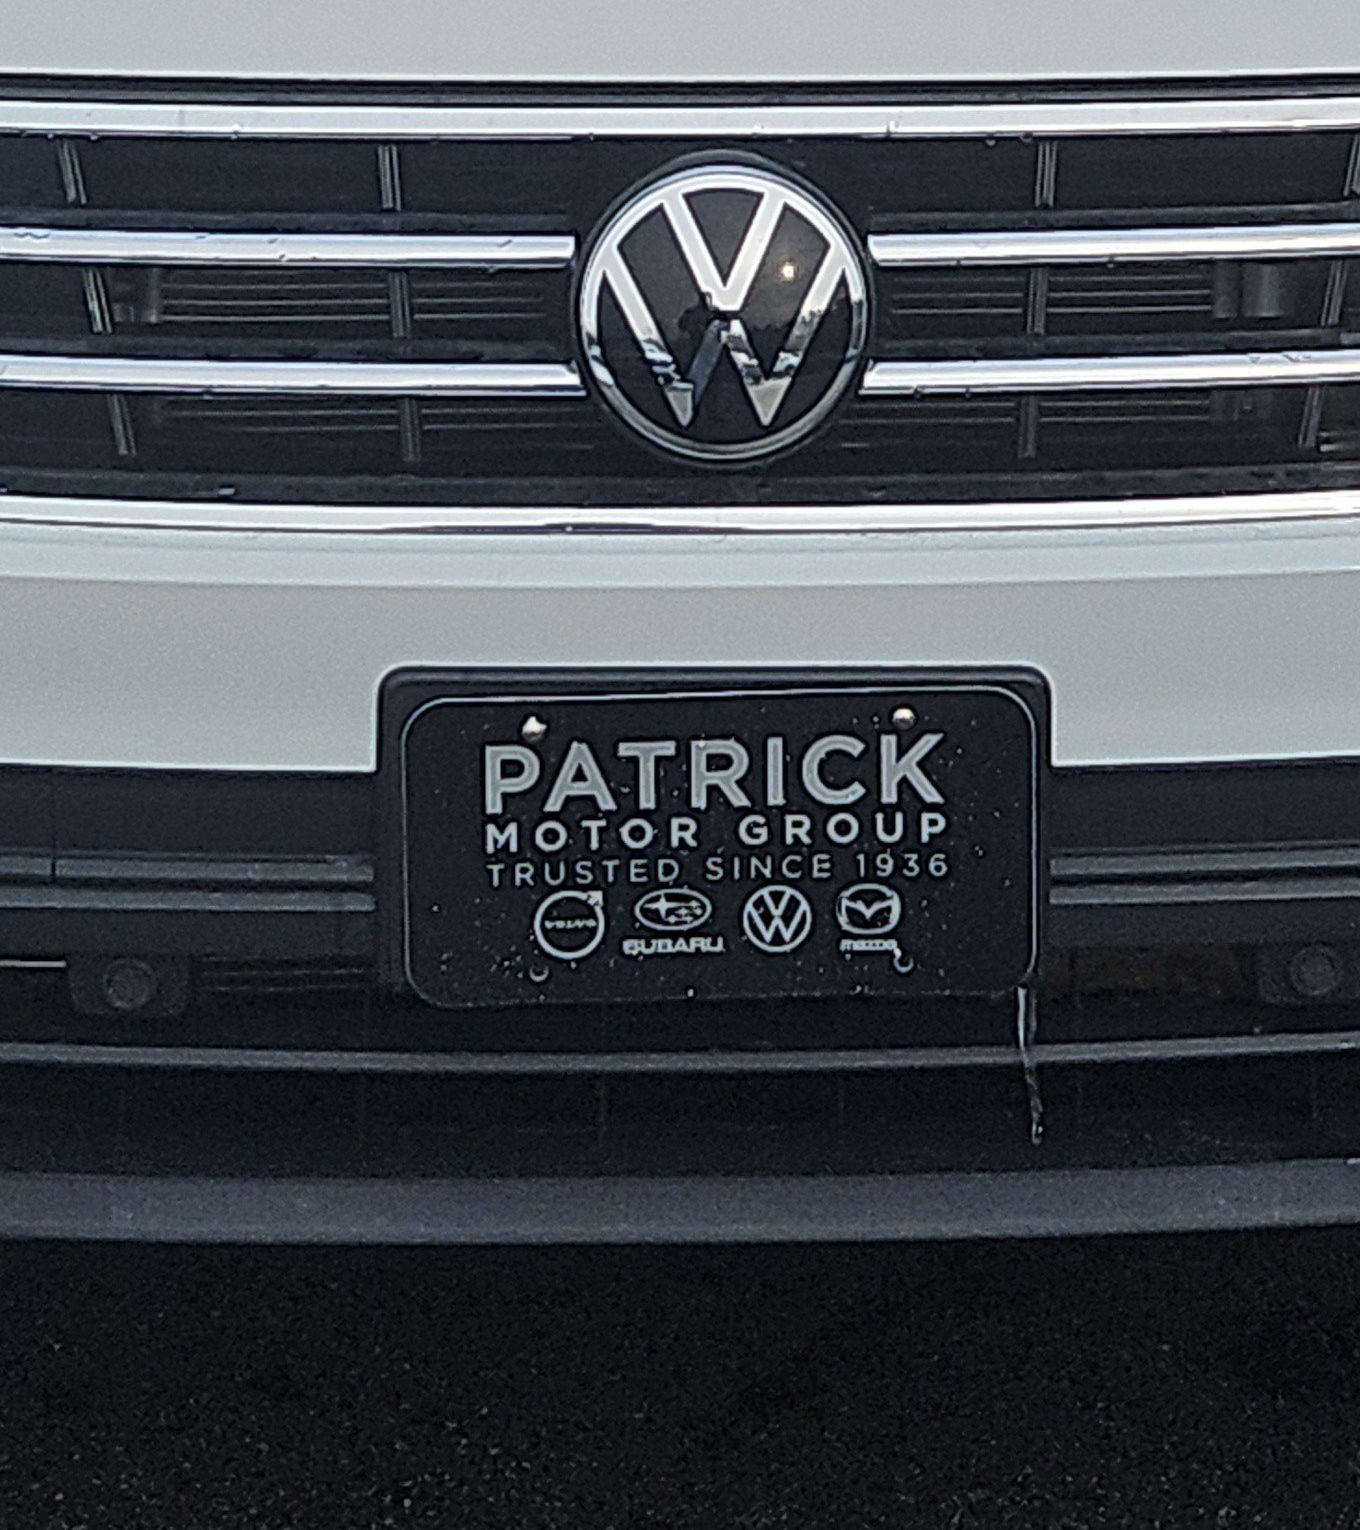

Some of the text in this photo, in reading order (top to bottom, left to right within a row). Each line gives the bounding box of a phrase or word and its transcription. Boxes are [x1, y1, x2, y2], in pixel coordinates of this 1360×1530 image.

[484, 732, 946, 815] PATRICK
[485, 811, 948, 855] MOTOR GROUP
[486, 851, 949, 889] TRUSTED SINCE 1936
[543, 918, 599, 929] VOLVO
[622, 937, 725, 956] SUBARU
